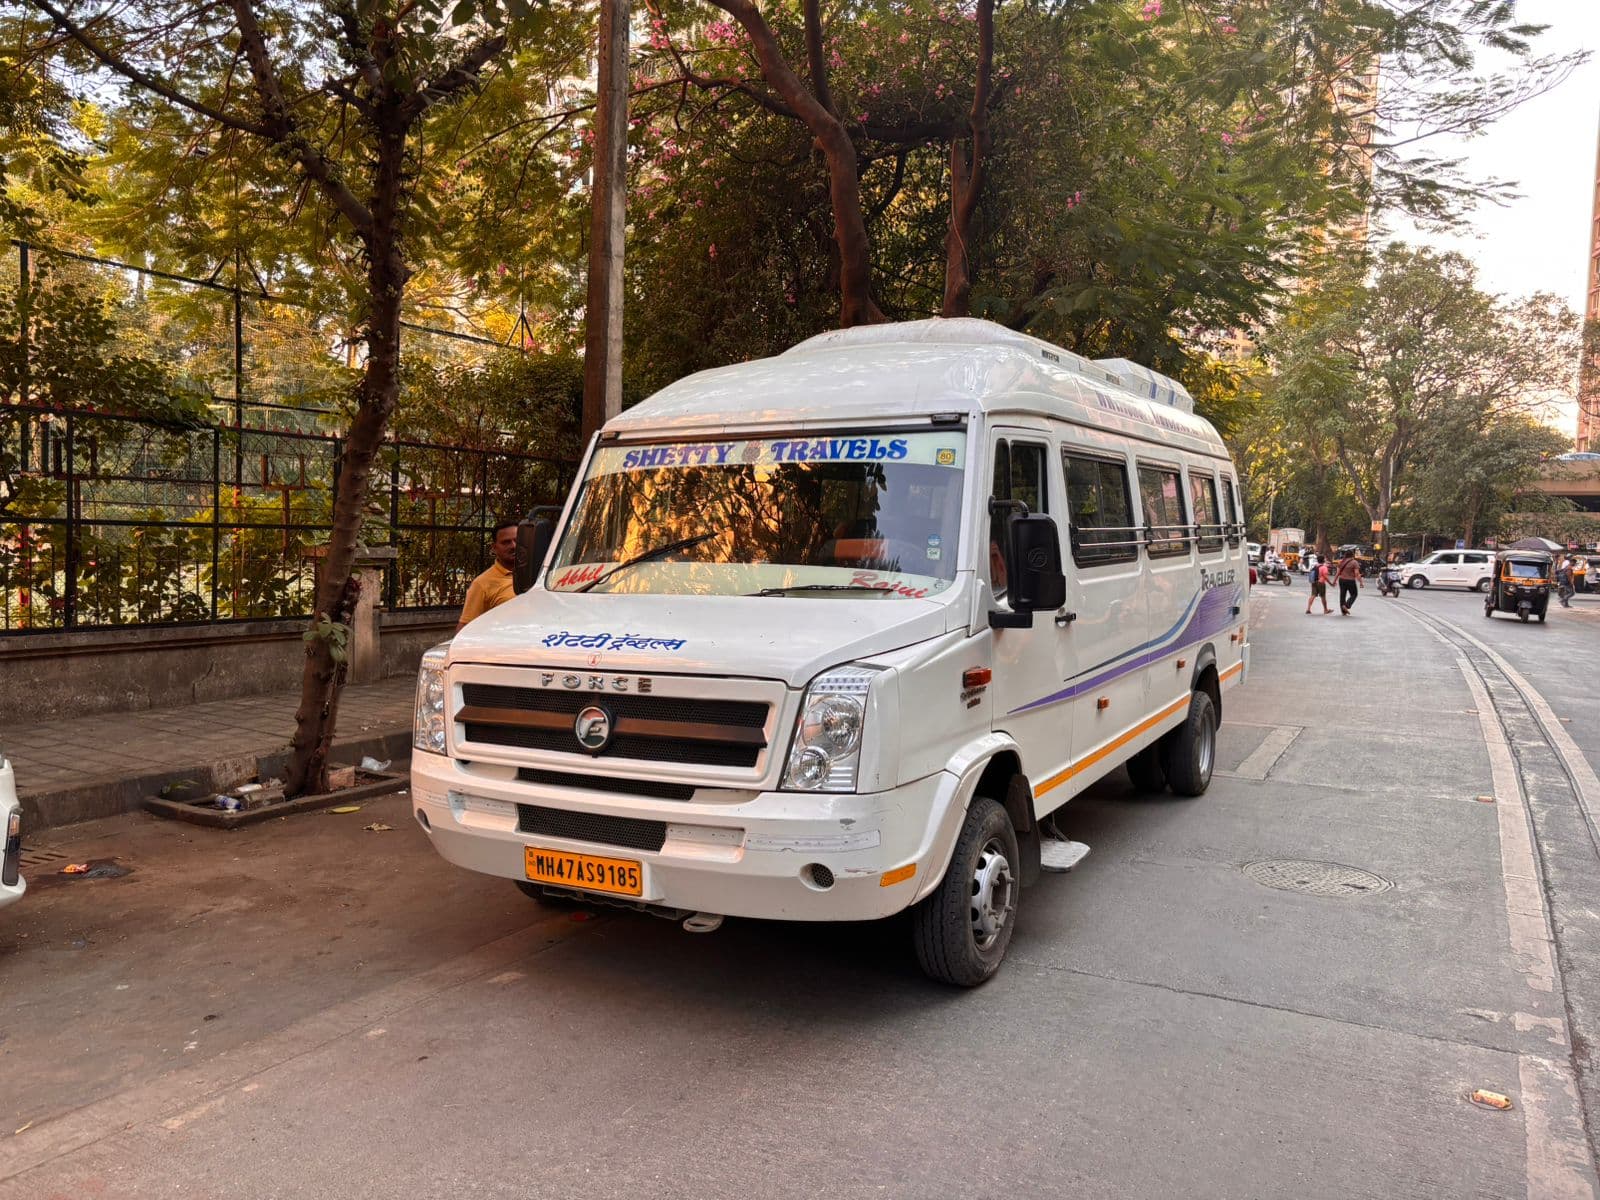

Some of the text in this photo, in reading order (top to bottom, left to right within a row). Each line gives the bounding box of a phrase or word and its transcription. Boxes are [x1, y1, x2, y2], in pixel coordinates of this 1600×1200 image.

[622, 438, 908, 468] SHETTY TRAVELS
[552, 564, 605, 590] Akhil
[541, 672, 653, 693] FORCE
[536, 854, 638, 888] MH47AS9185
